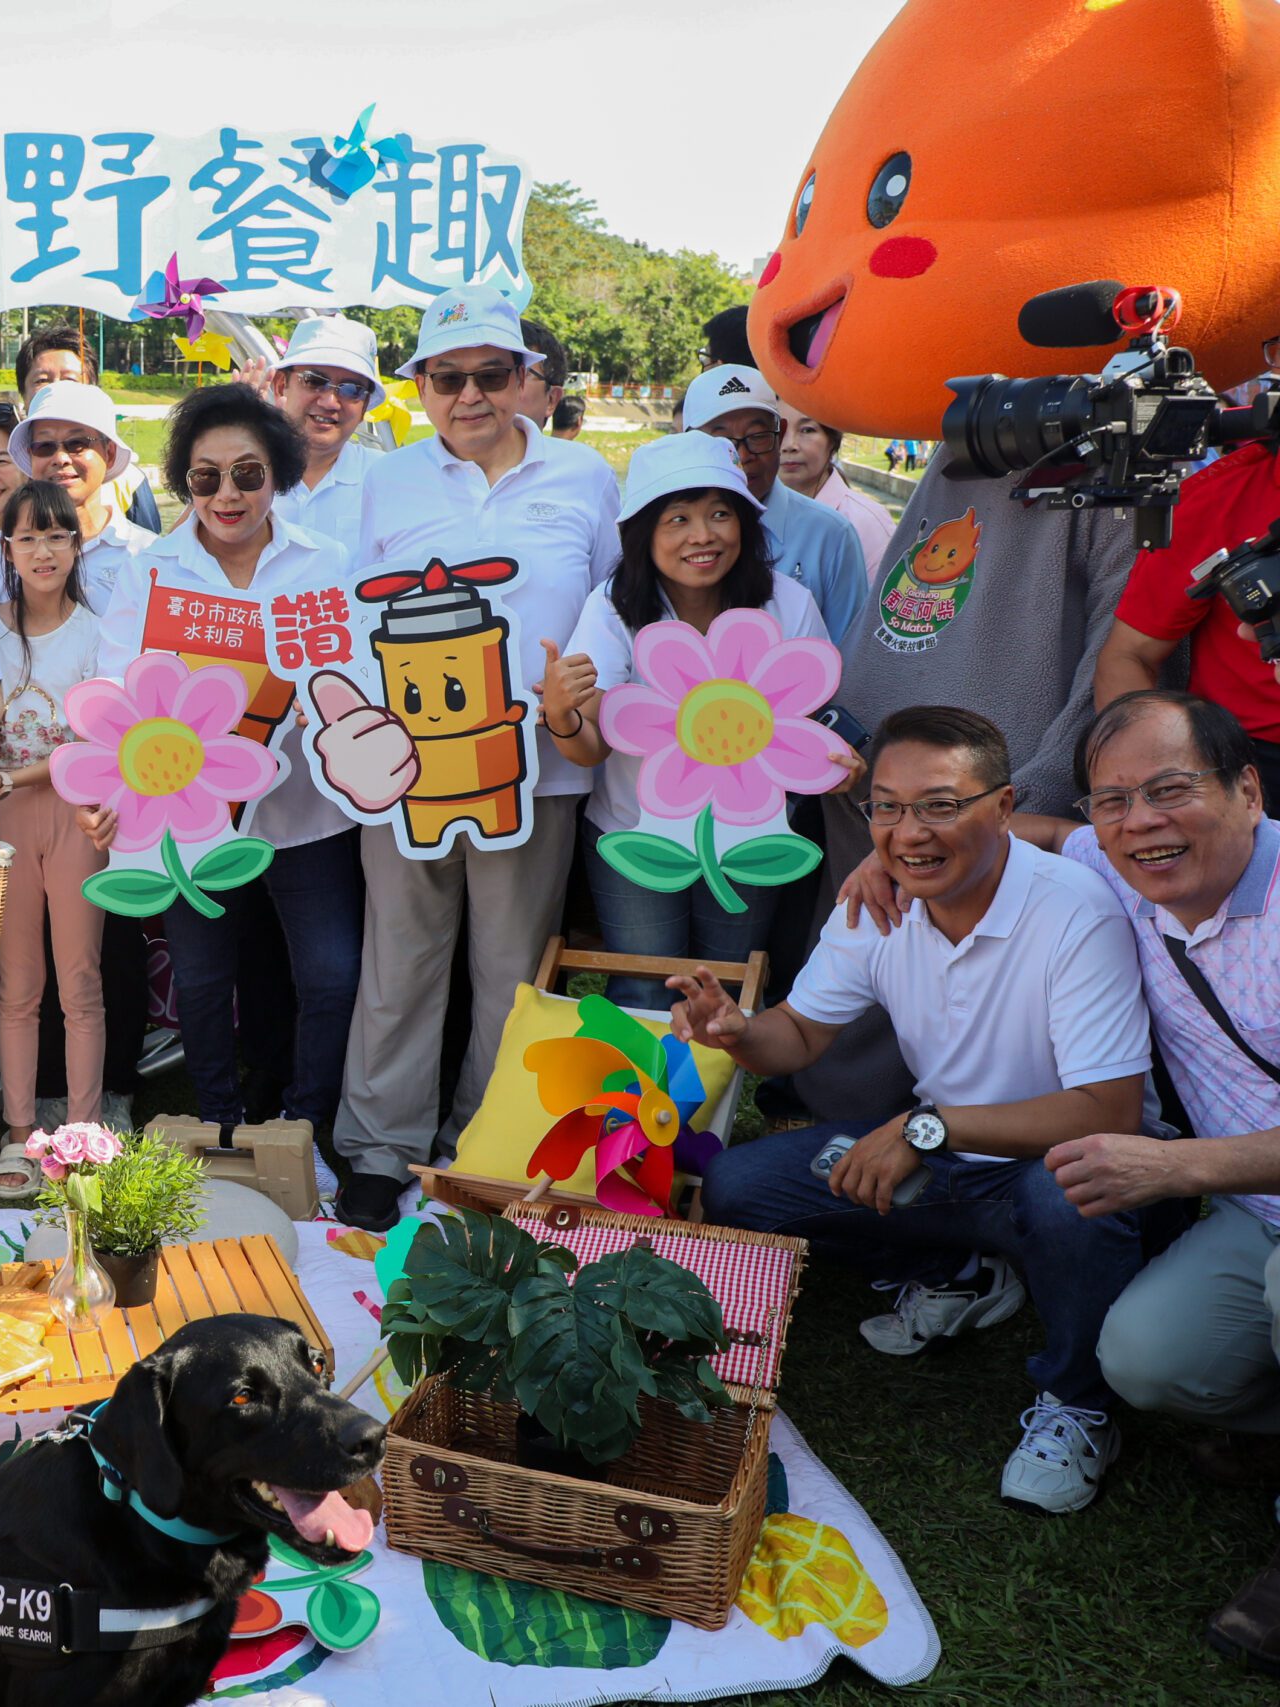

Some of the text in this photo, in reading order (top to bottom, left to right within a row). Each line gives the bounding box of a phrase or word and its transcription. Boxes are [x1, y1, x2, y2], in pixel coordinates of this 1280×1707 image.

[719, 386, 751, 396] adidas
[166, 595, 264, 630] 臺中市政府
[882, 588, 955, 621] 南區阿柴
[183, 622, 244, 648] 水利局
[271, 586, 354, 670] 讚
[888, 616, 934, 633] So Match
[18, 1628, 52, 1645] SEARCH
